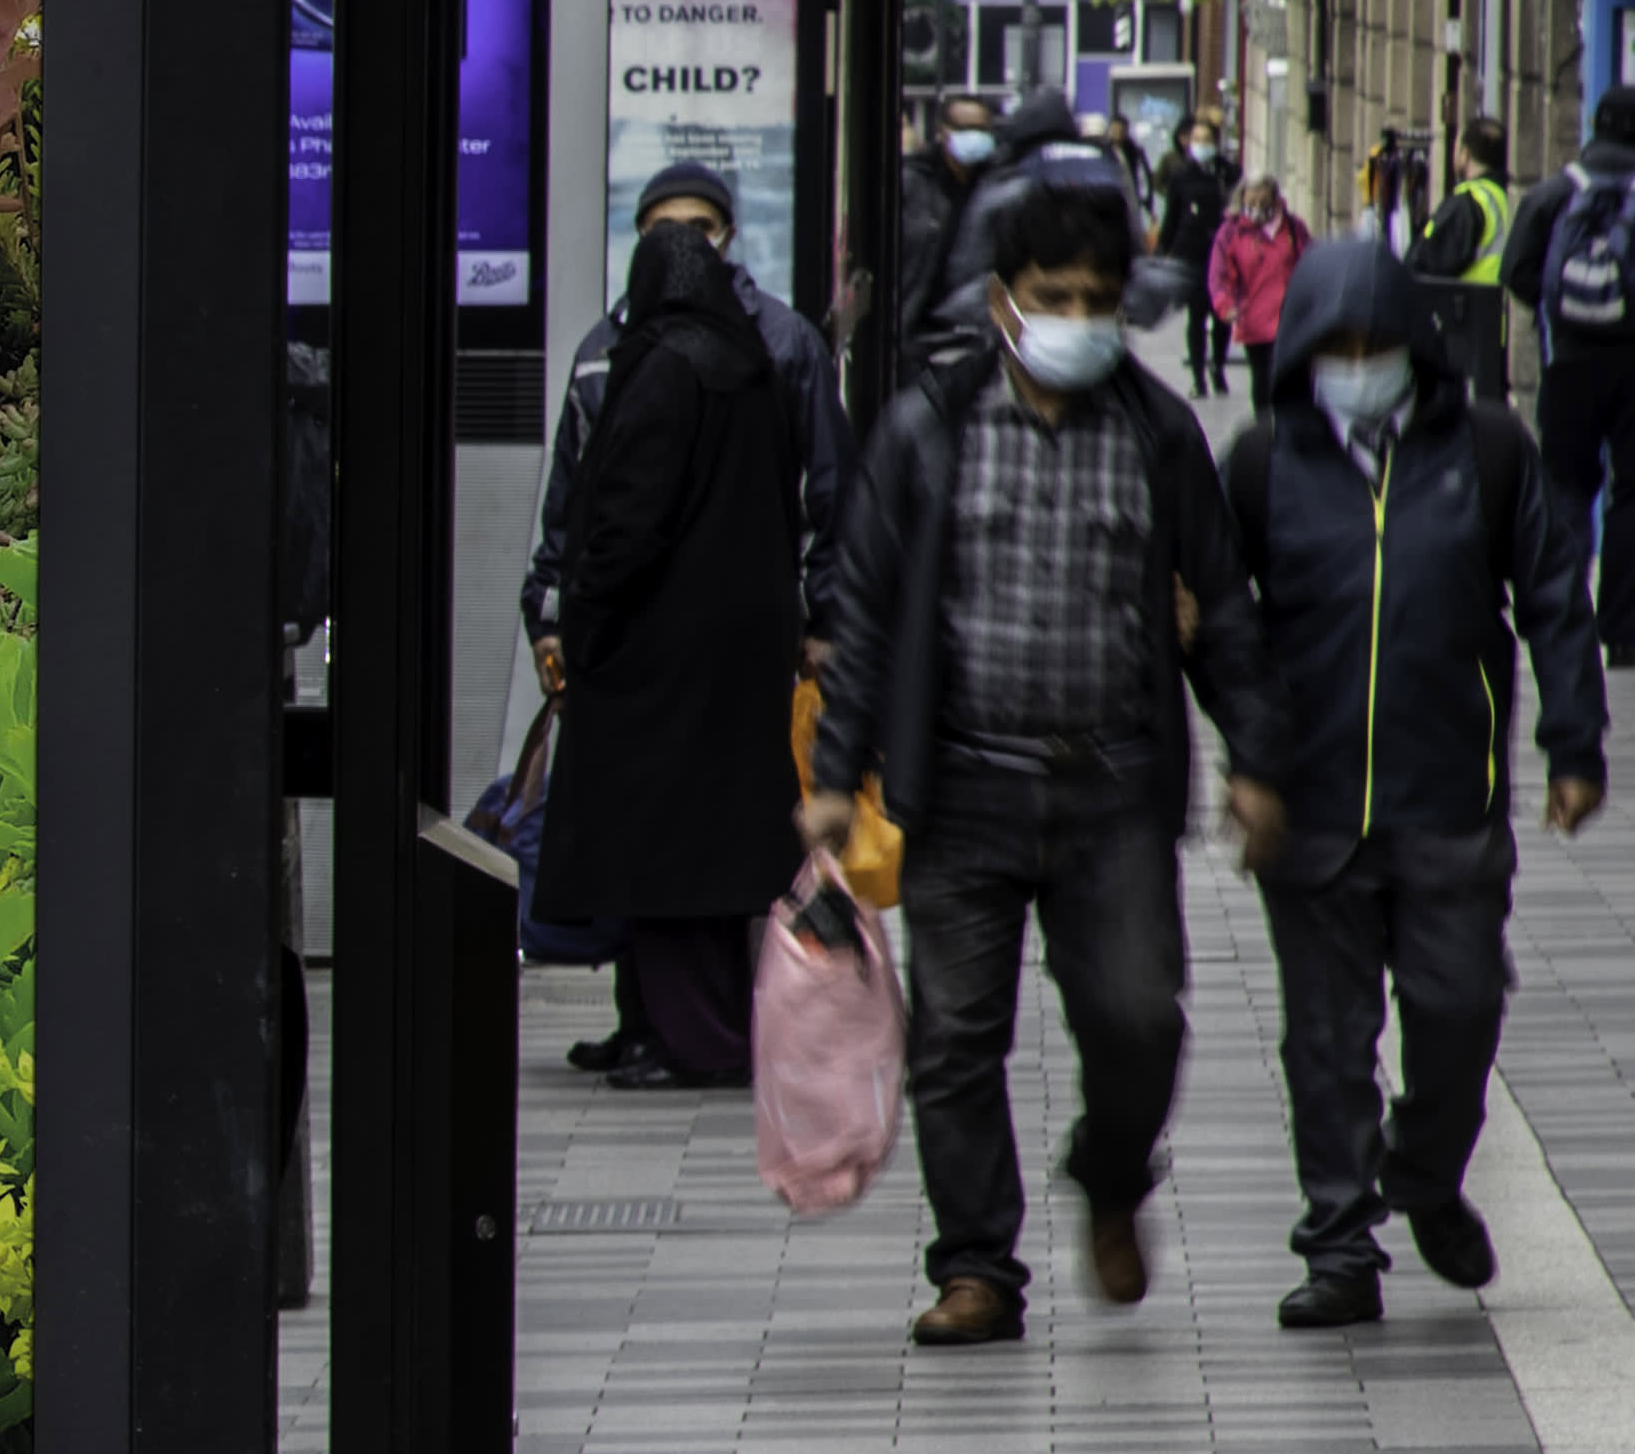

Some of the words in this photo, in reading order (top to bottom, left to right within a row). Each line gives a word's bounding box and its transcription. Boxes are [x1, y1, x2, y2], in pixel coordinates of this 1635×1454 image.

[621, 5, 651, 23] TO
[659, 5, 764, 24] DANGER.
[623, 66, 761, 93] CHILD?
